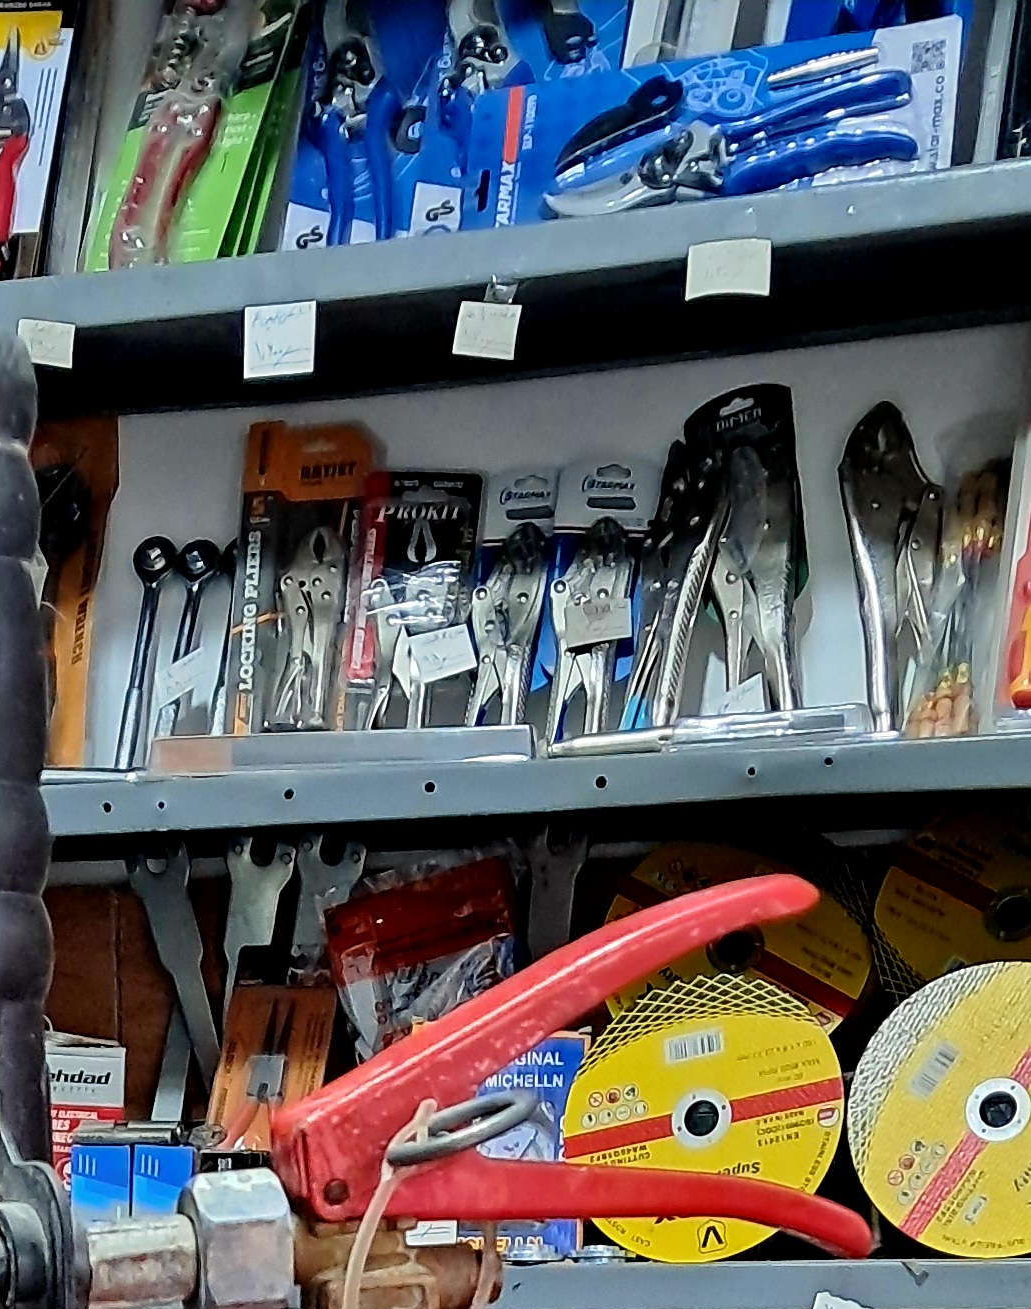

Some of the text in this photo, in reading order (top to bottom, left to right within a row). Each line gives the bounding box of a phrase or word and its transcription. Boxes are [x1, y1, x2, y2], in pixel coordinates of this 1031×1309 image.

[300, 462, 357, 481] RAYJET
[379, 504, 461, 523] PROKIT
[238, 530, 262, 692] LOCKING PLIERS
[485, 1073, 564, 1088] MICHELLN
